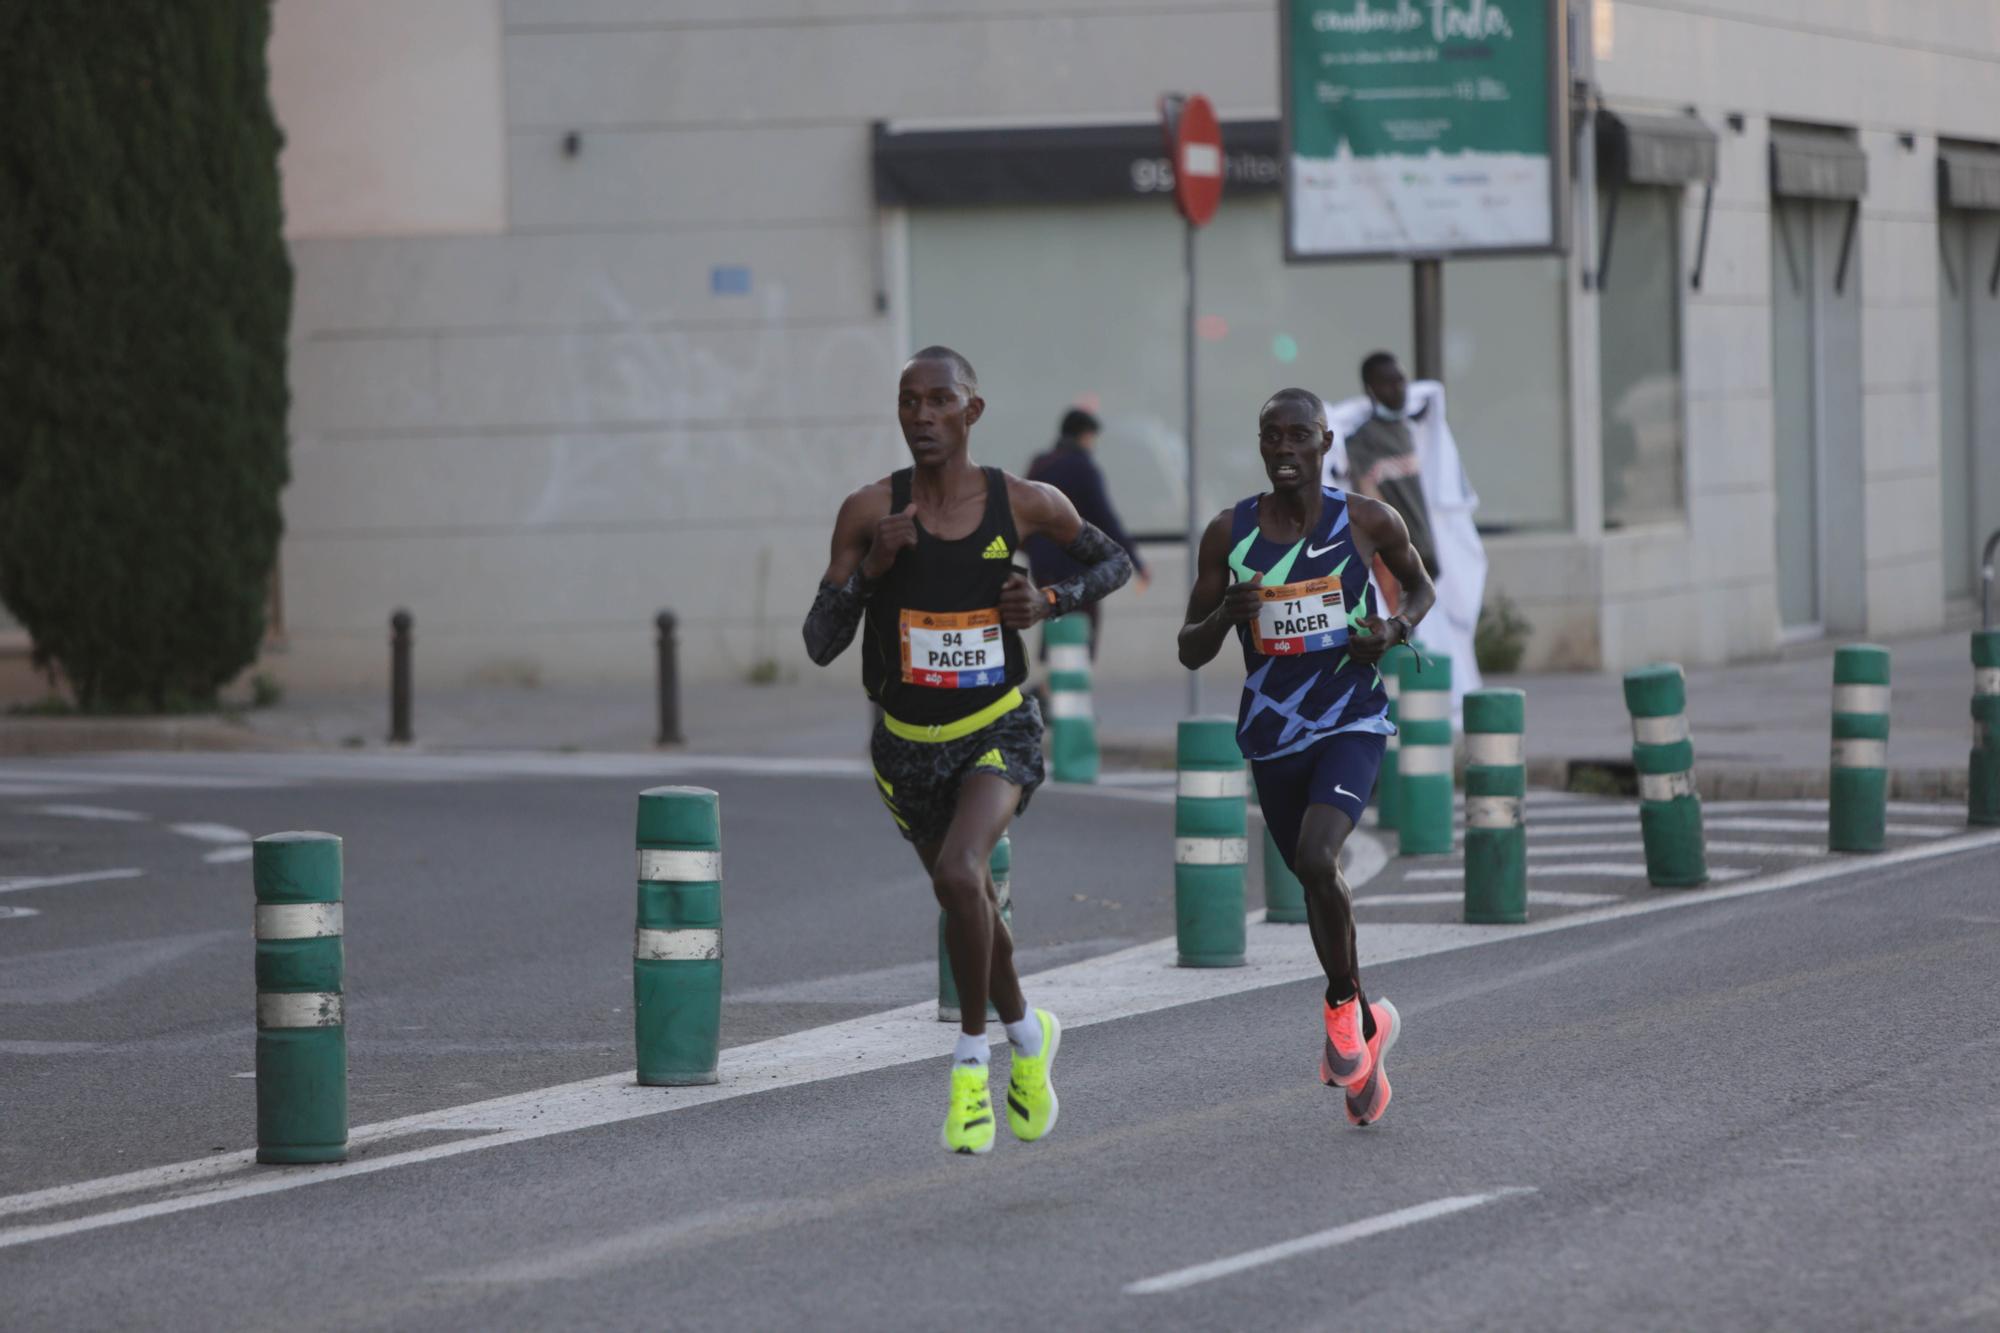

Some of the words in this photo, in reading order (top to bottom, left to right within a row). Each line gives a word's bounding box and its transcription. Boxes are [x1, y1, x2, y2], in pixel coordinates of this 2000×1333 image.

[1284, 601, 1302, 615] 71
[1274, 614, 1328, 635] PACER
[942, 633, 962, 646] 94
[928, 650, 987, 667] PACER
